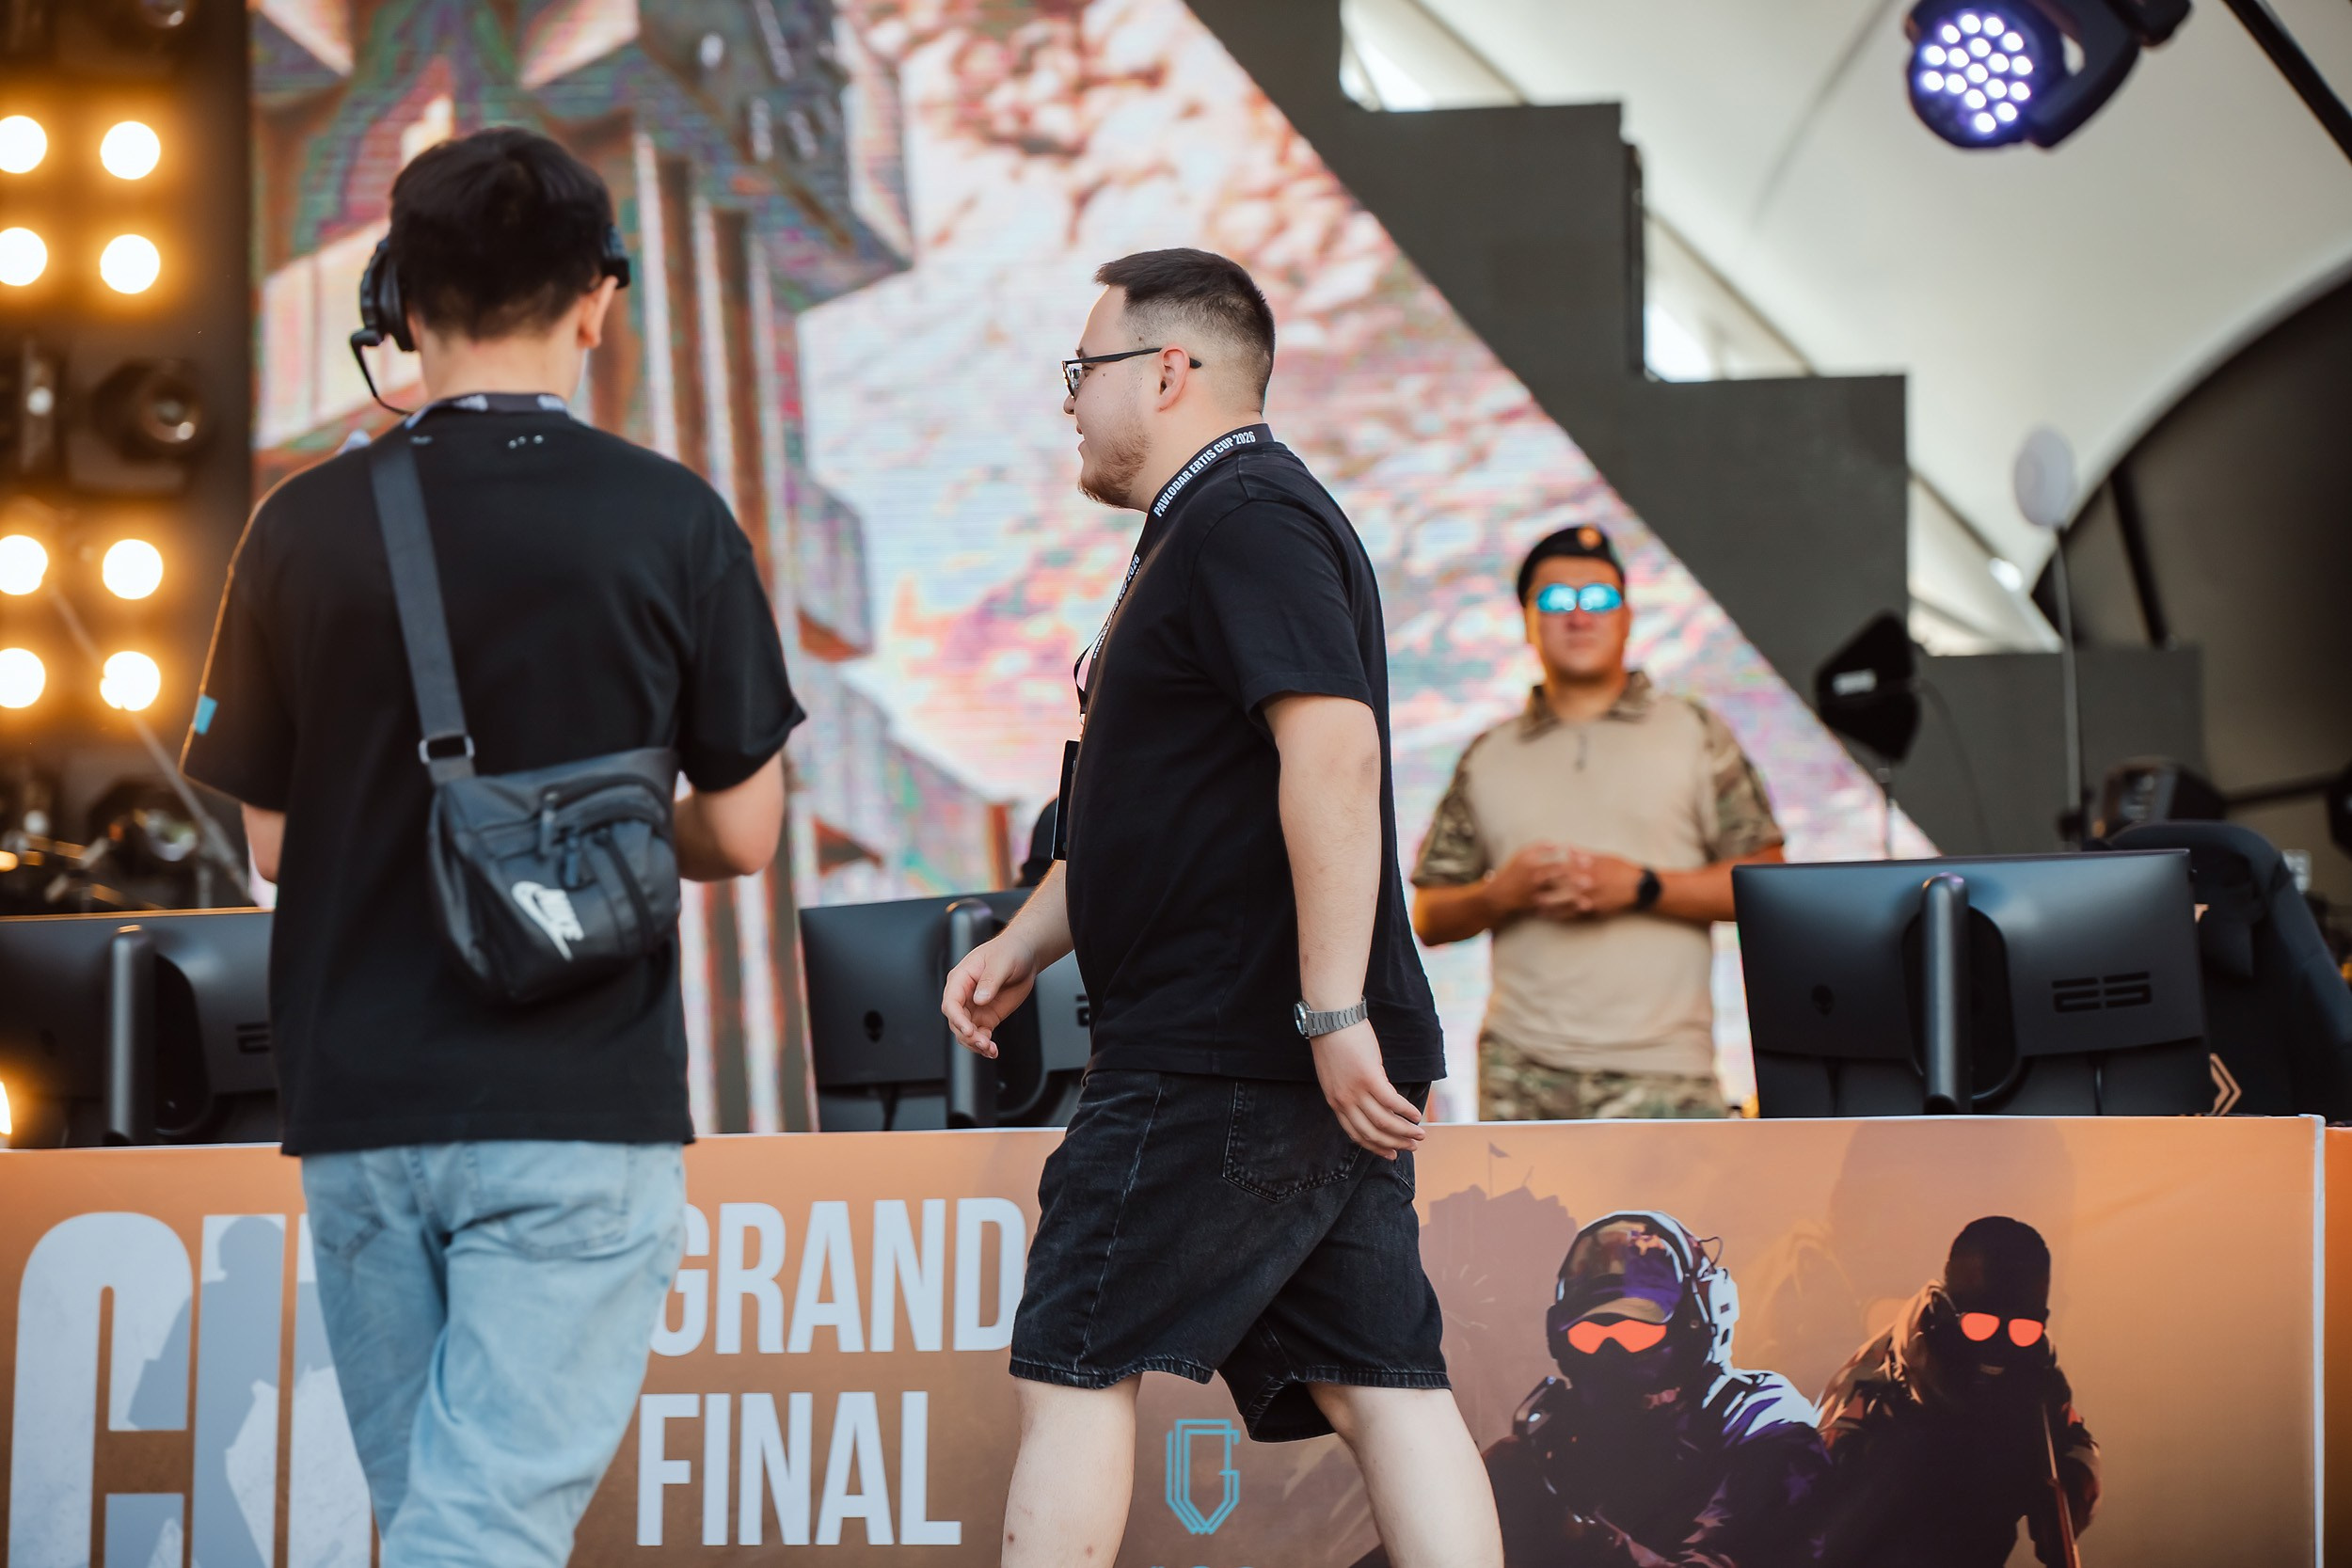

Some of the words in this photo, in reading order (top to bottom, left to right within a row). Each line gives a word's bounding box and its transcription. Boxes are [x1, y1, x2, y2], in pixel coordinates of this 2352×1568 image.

[1153, 470, 1193, 517] PAVLODAR
[1188, 449, 1217, 475] ERTIS
[1213, 436, 1234, 453] CUP
[1232, 431, 1257, 446] 2026
[649, 1196, 1027, 1356] GRAND
[6, 1211, 380, 1568] CU
[636, 1390, 962, 1546] FINAL
